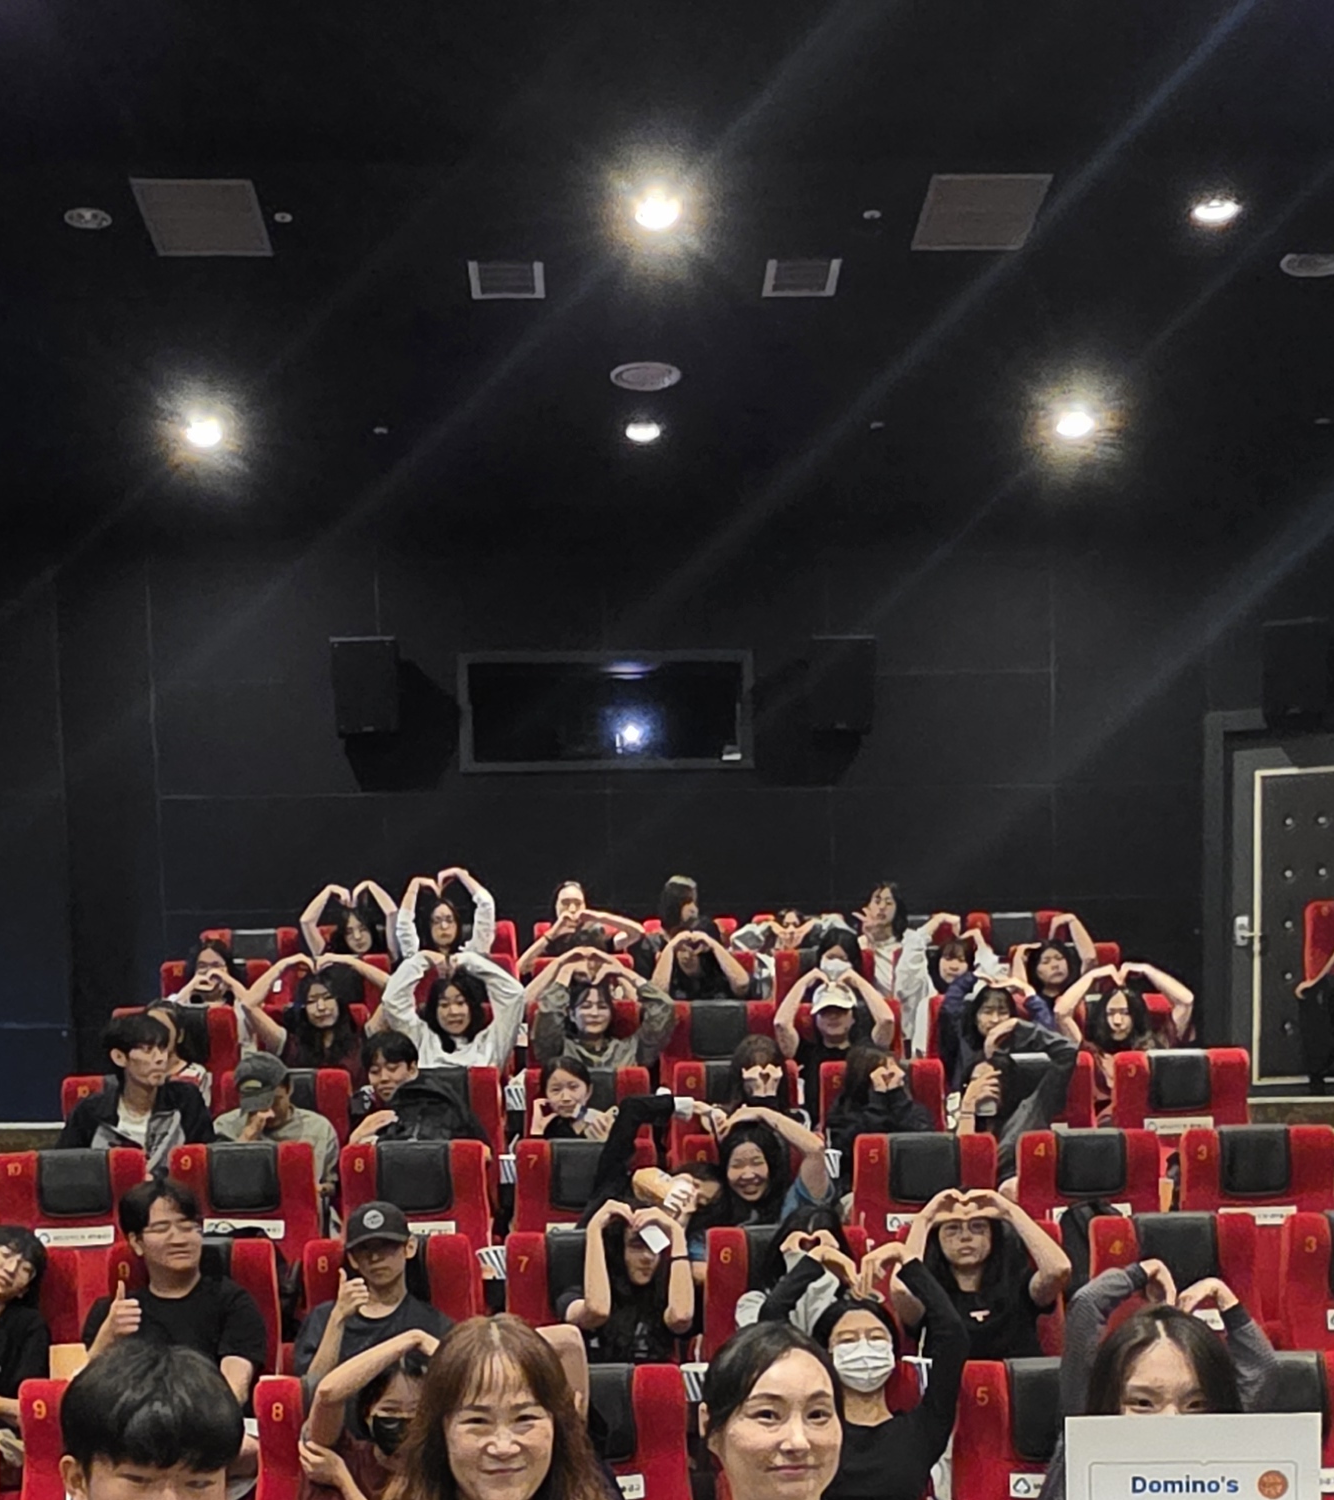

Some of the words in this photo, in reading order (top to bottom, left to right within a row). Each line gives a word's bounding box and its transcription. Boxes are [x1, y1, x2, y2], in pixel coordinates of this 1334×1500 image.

[868, 1149, 879, 1164] 5
[1033, 1143, 1045, 1158] 4
[1197, 1145, 1208, 1160] 3
[6, 1162, 22, 1177] 10
[180, 1155, 192, 1171] 9
[354, 1157, 365, 1173] 8
[527, 1154, 538, 1169] 7
[1305, 1236, 1318, 1254] 3
[720, 1247, 732, 1264] 6
[317, 1256, 328, 1273] 8
[518, 1256, 530, 1273] 7
[976, 1387, 989, 1406] 5
[32, 1399, 46, 1419] 9
[272, 1402, 284, 1422] 8
[1131, 1475, 1239, 1494] Domino's
